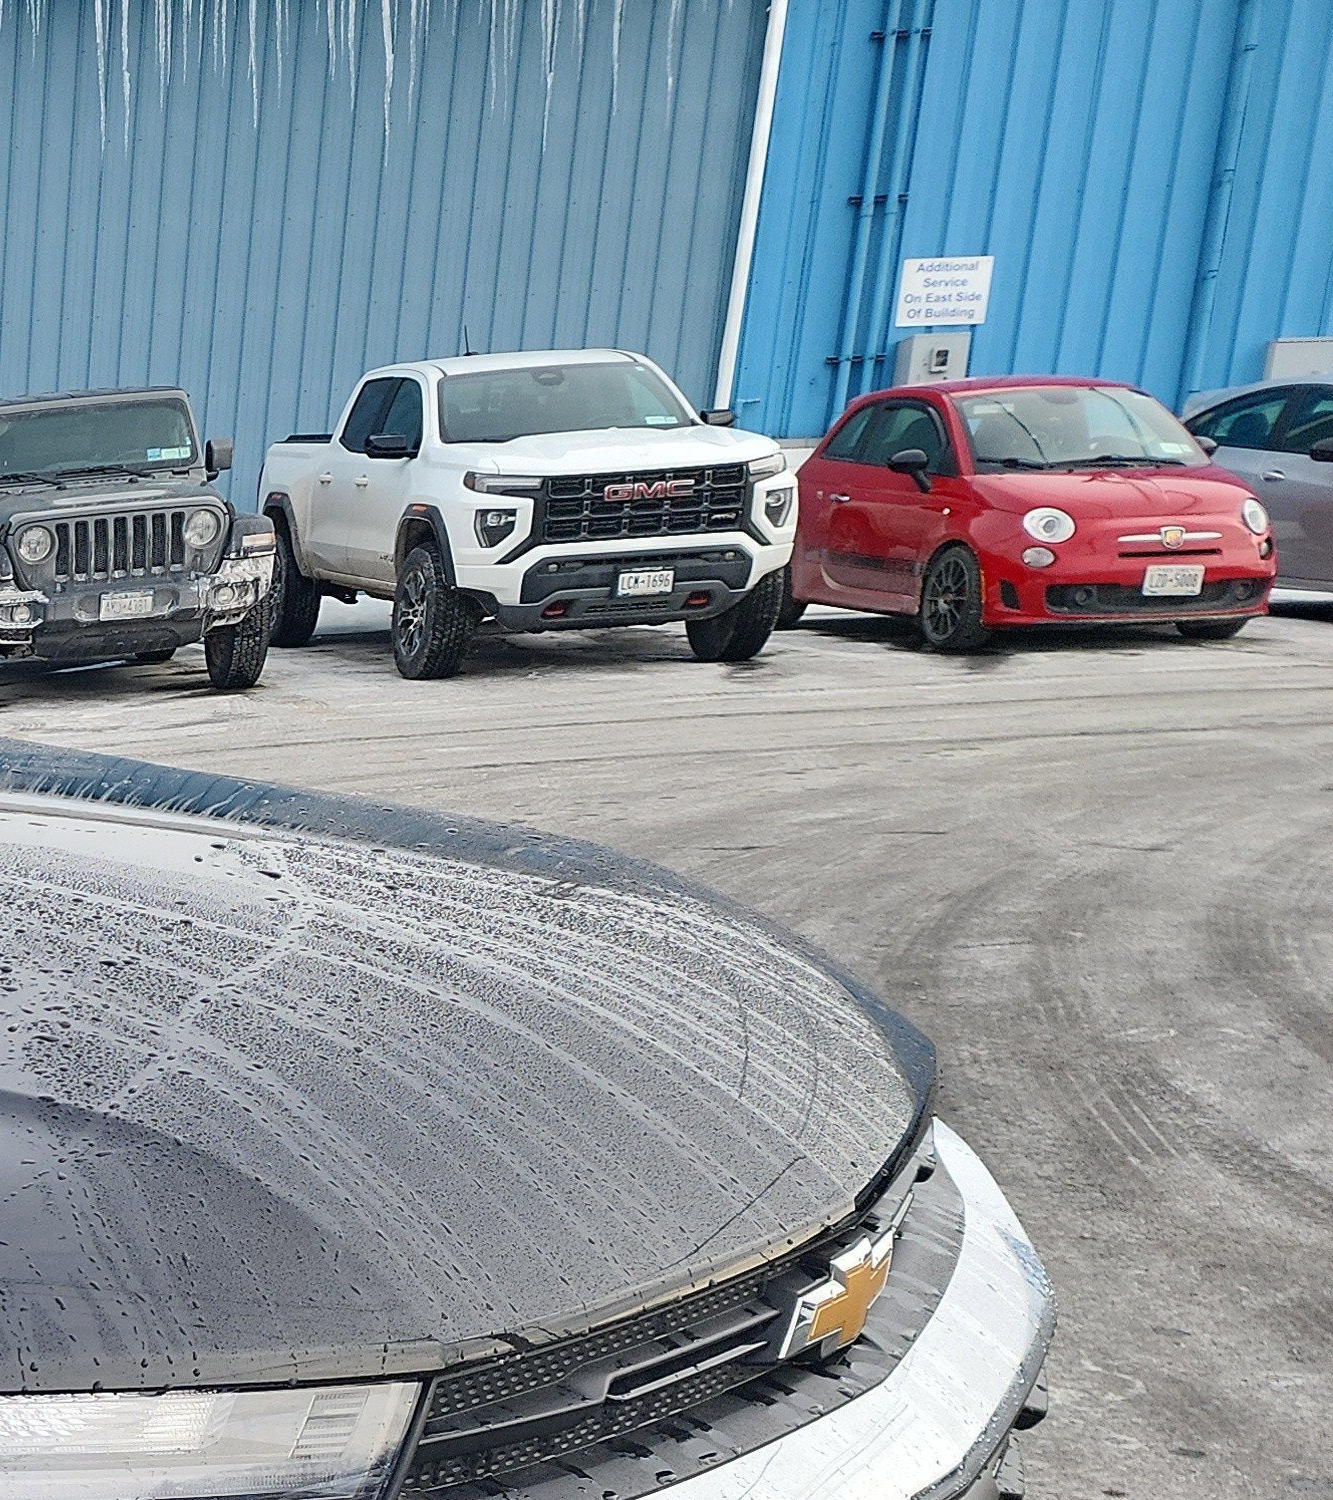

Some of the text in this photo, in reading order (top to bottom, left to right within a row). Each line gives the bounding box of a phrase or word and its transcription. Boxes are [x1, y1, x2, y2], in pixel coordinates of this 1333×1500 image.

[916, 260, 980, 273] Additional
[923, 277, 969, 288] Service
[904, 291, 983, 304] On East Side
[907, 307, 975, 320] Of Building
[603, 479, 696, 502] GMC
